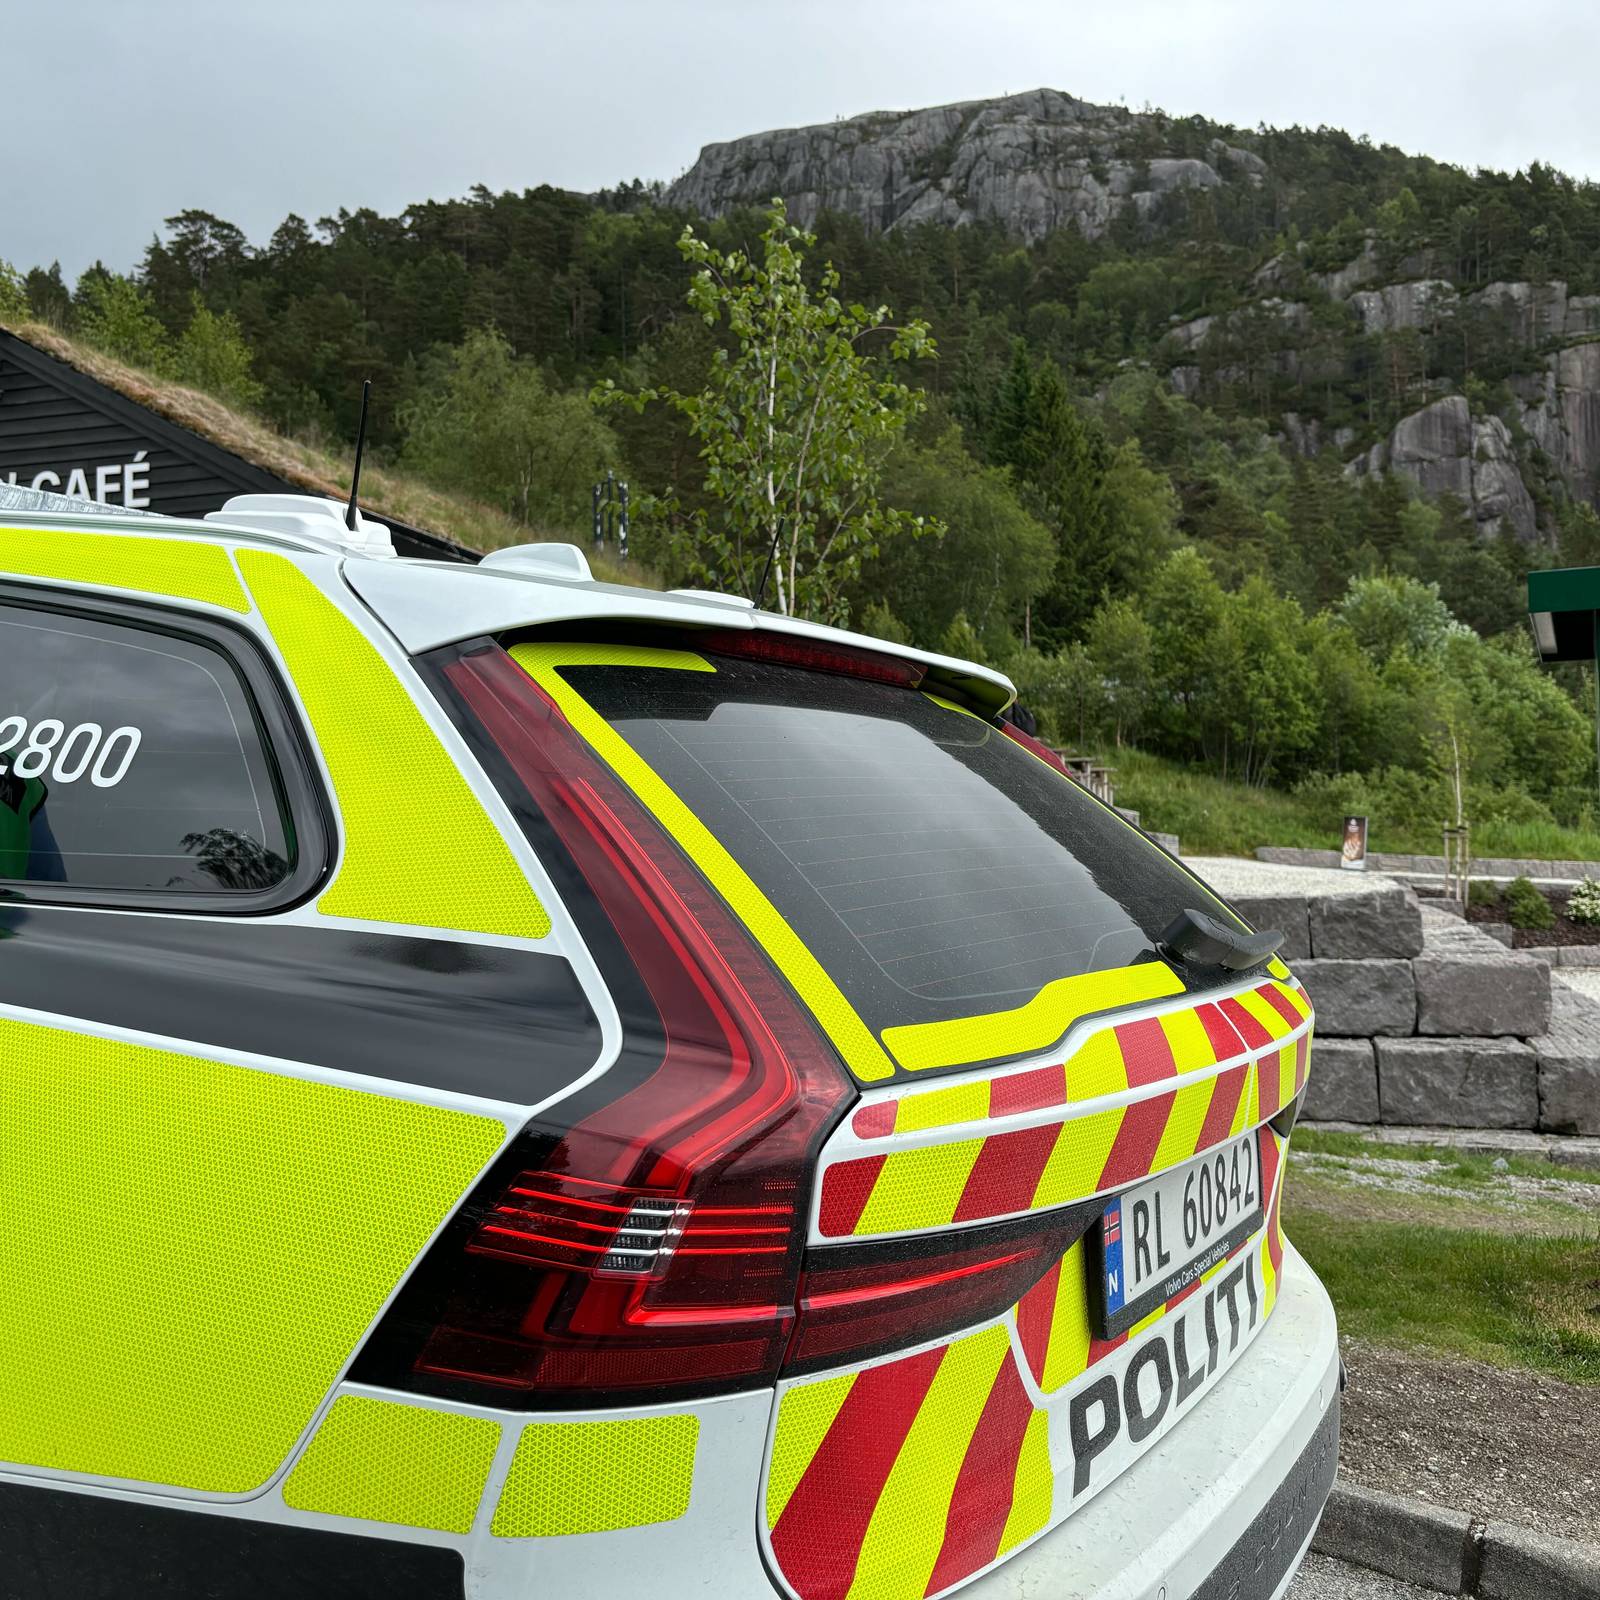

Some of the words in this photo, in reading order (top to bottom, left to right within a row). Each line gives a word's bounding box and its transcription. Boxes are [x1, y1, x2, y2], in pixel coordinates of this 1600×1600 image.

[1132, 1190, 1171, 1284] RL
[1183, 1137, 1255, 1249] 60842
[1108, 1269, 1119, 1297] N
[1164, 1277, 1182, 1297] Volvo
[1181, 1269, 1194, 1286] Cars
[1193, 1250, 1212, 1278] Special
[1210, 1239, 1230, 1262] Vehicles
[1069, 1251, 1258, 1499] POLITI
